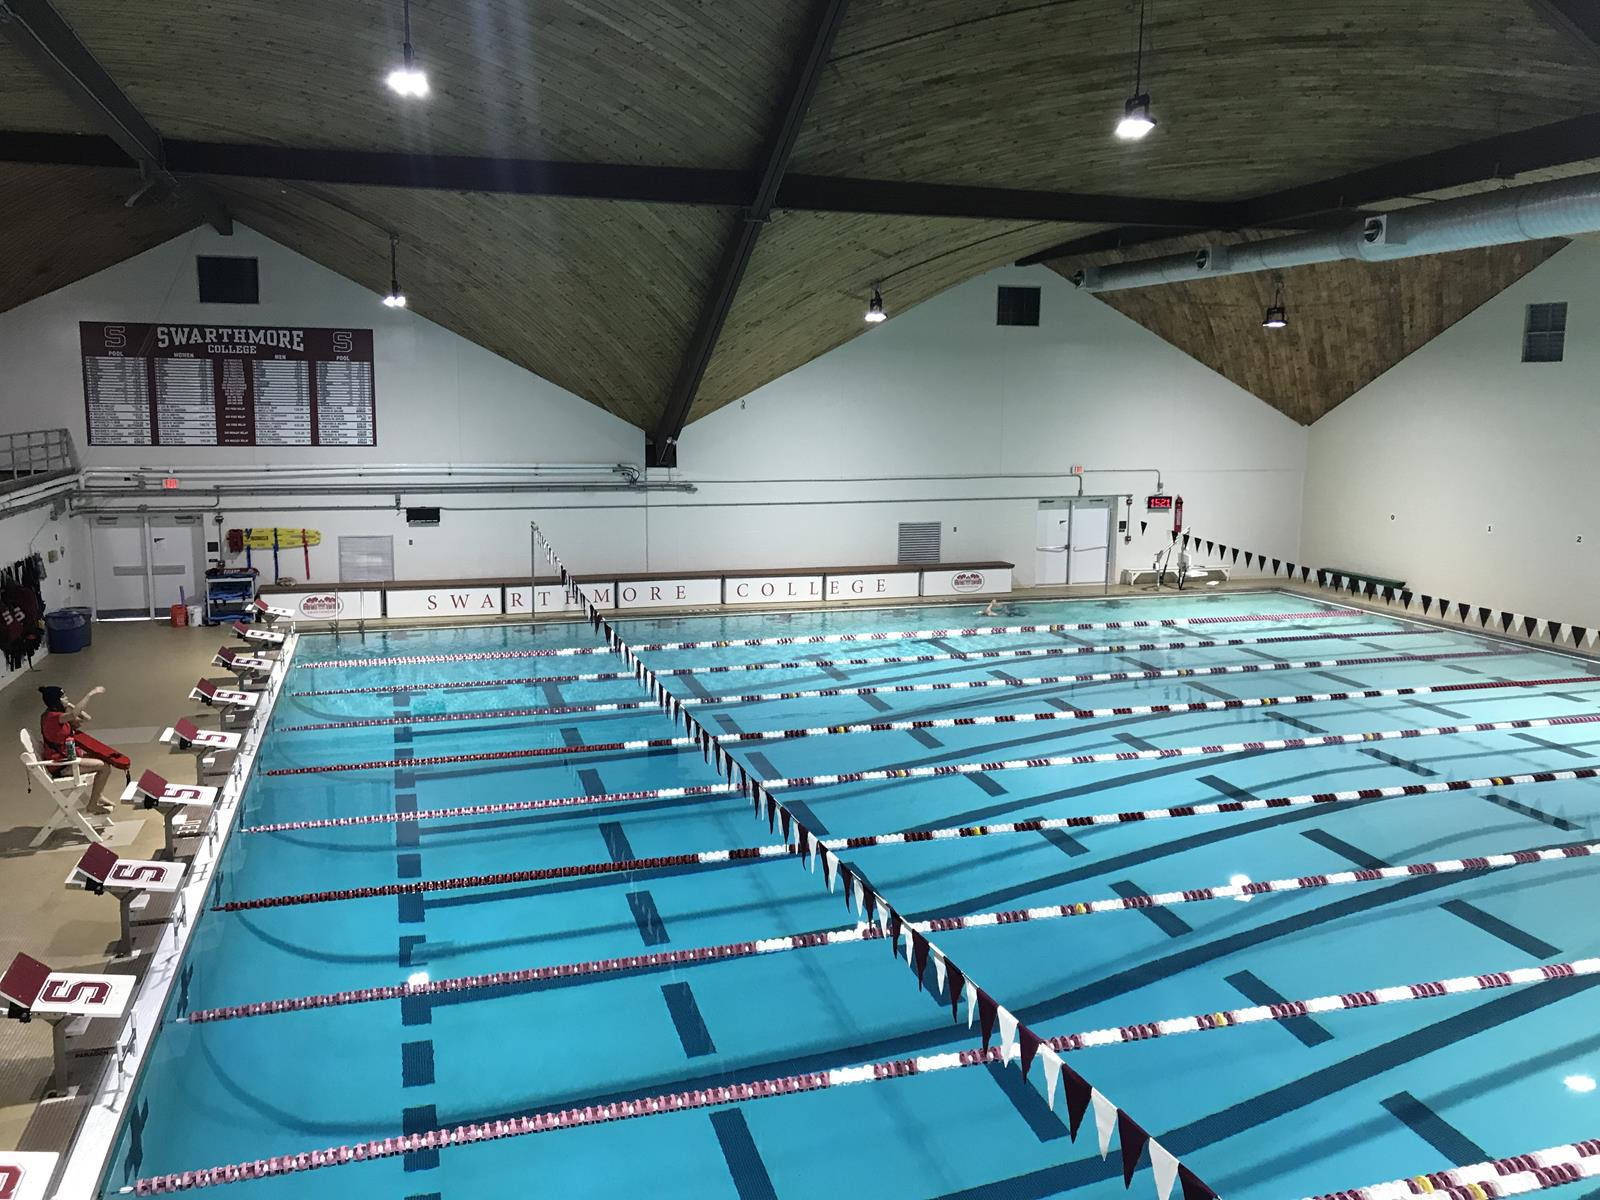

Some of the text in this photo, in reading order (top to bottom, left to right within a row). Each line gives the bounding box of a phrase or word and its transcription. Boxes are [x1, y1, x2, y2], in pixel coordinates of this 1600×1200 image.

[104, 325, 127, 348] S
[157, 326, 304, 352] SWARTHMORE
[332, 331, 353, 353] S
[207, 344, 257, 355] COLLEGE
[1576, 535, 1582, 543] 2
[736, 578, 886, 598] COLLEGE
[110, 863, 169, 884] S
[38, 980, 113, 1005] S
